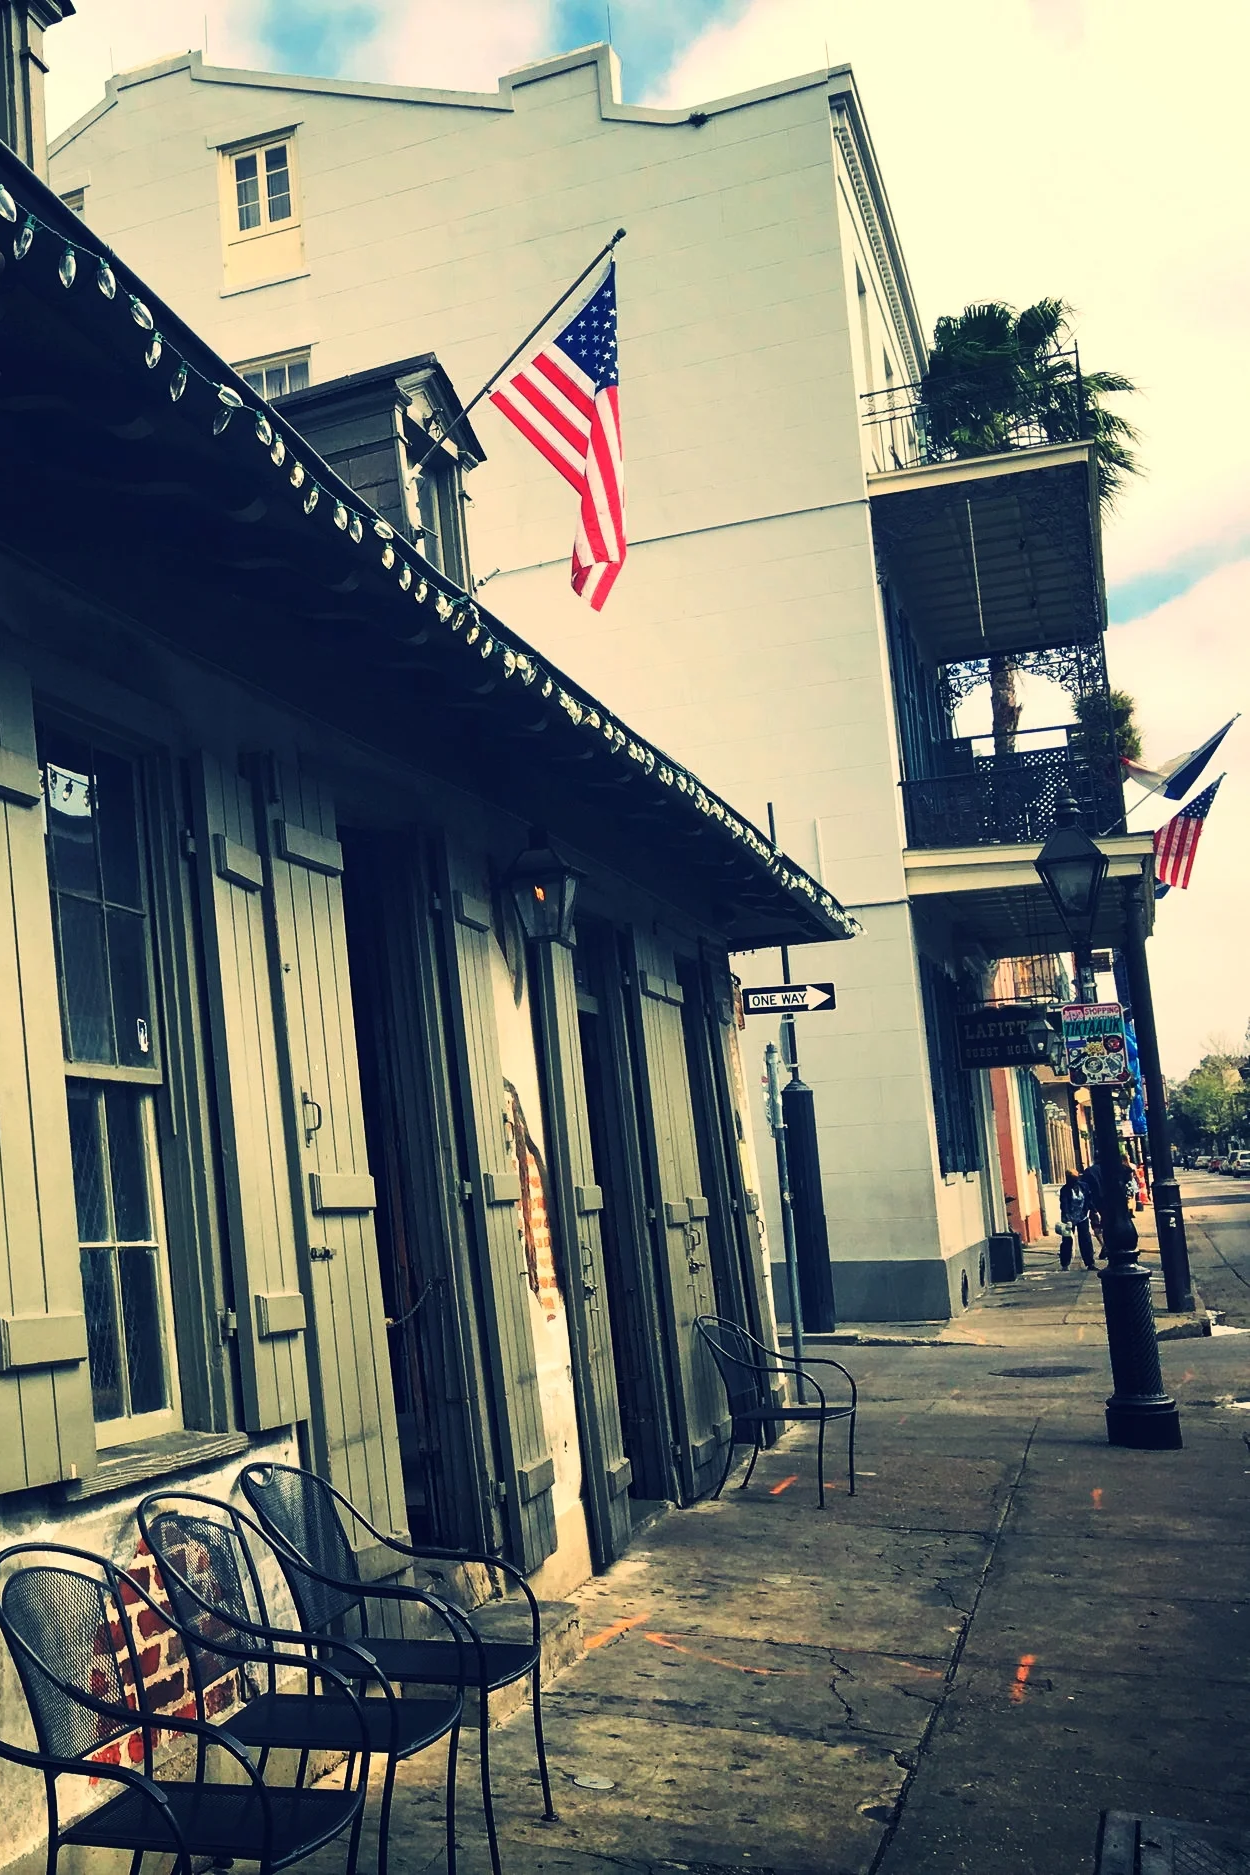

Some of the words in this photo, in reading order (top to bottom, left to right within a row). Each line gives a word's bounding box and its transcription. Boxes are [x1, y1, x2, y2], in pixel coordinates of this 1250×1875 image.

[752, 994, 777, 1007] ONE
[781, 992, 807, 1005] WAY
[1084, 1006, 1119, 1016] STOPPING
[963, 1020, 1028, 1040] LAFITT
[1065, 1018, 1121, 1037] TIKTAALIK
[1007, 1044, 1030, 1055] HOU
